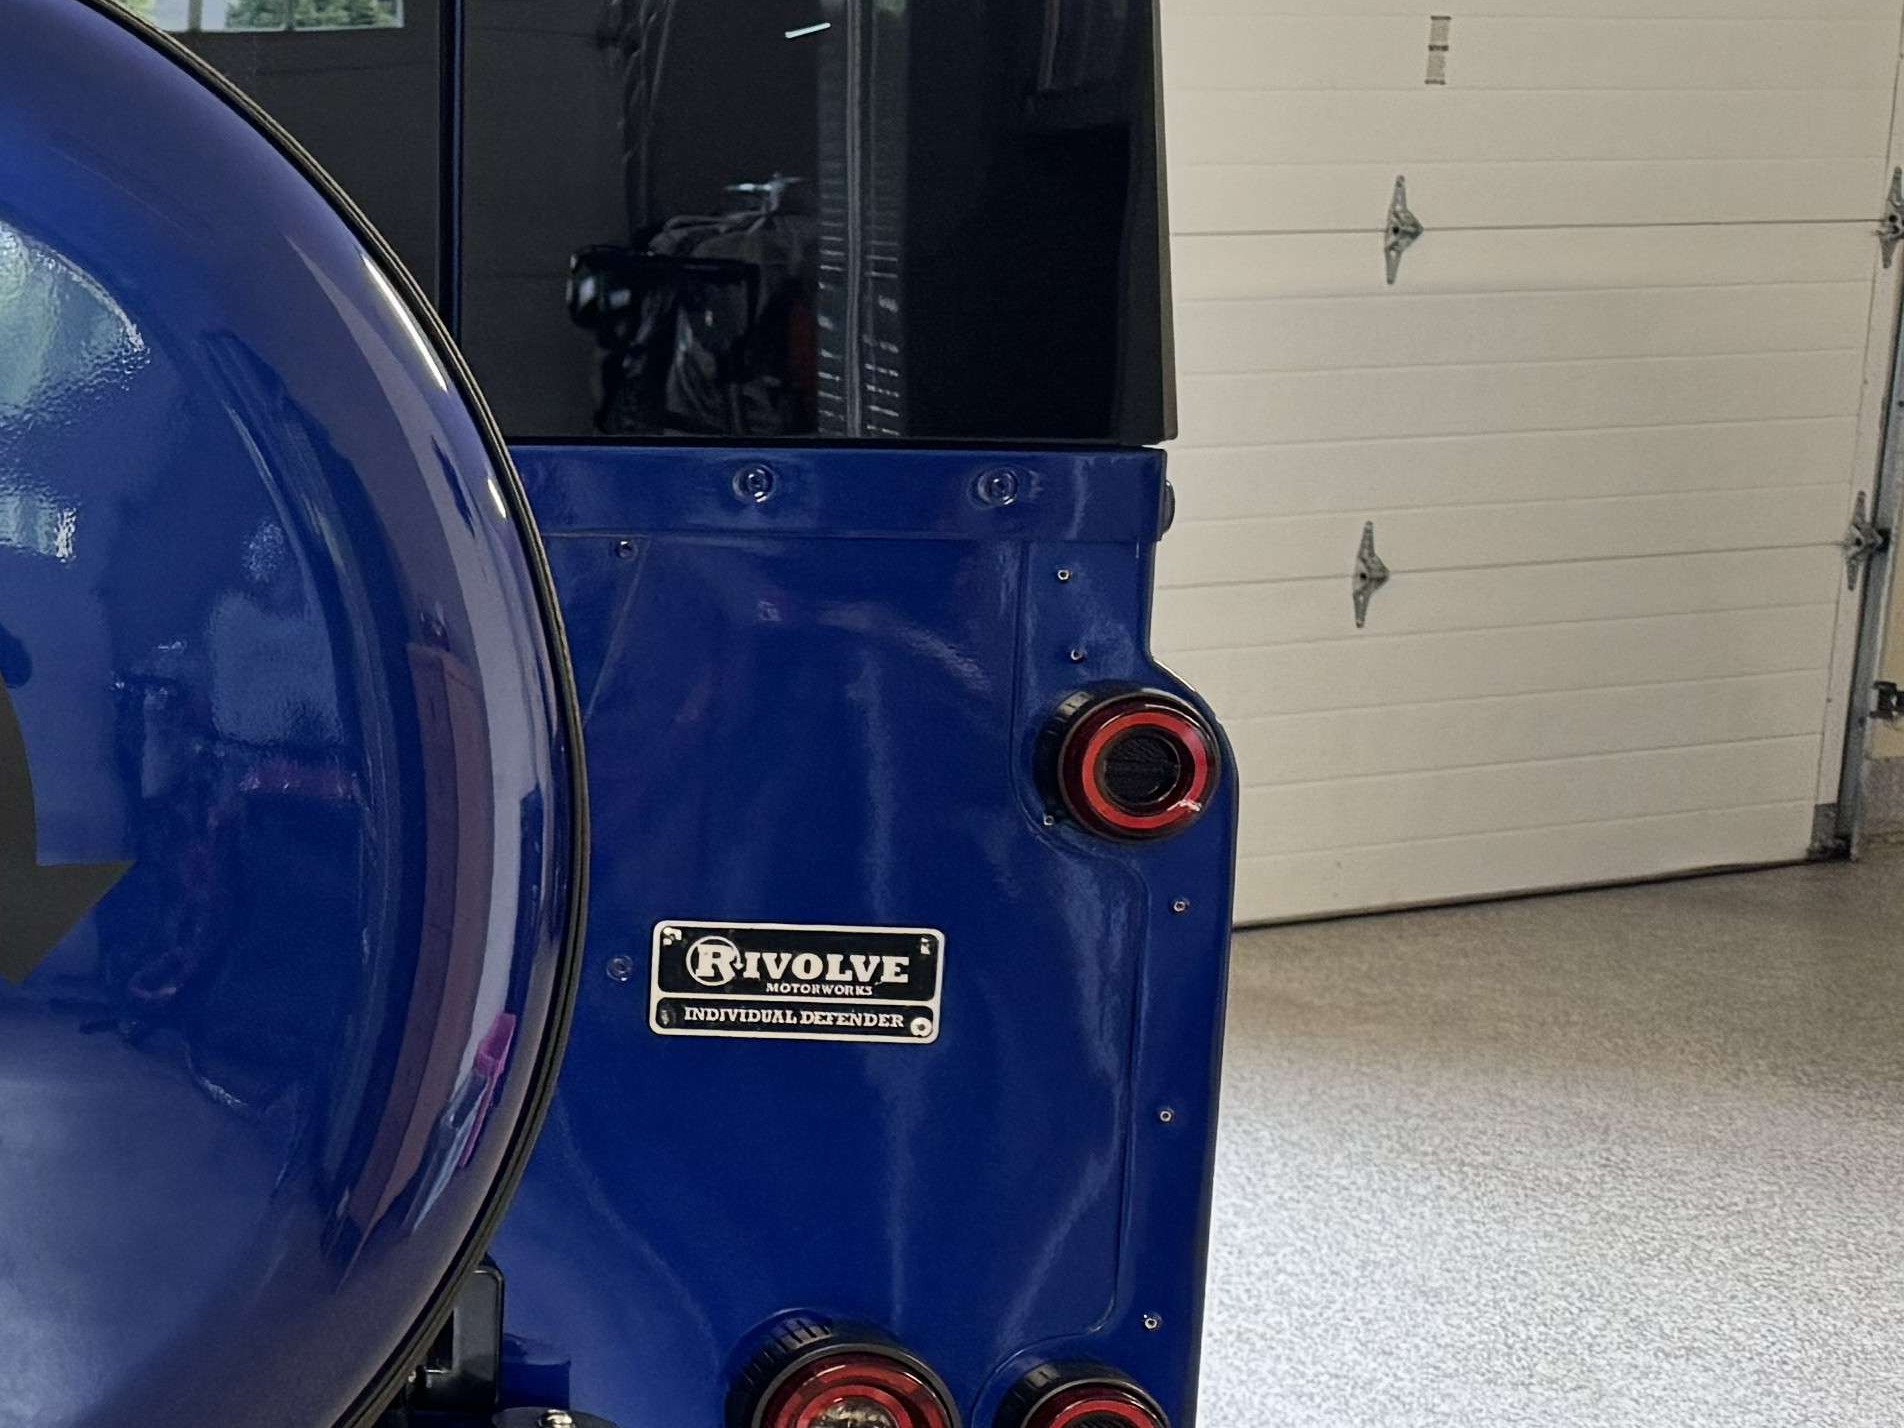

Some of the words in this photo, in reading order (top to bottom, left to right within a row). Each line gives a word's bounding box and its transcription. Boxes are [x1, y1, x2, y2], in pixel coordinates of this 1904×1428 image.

[694, 942, 910, 985] RIVOLVE
[765, 982, 873, 997] MOTORWORKS
[683, 1006, 798, 1024] INDIVIDUAL
[799, 1011, 905, 1029] DEFENDER
